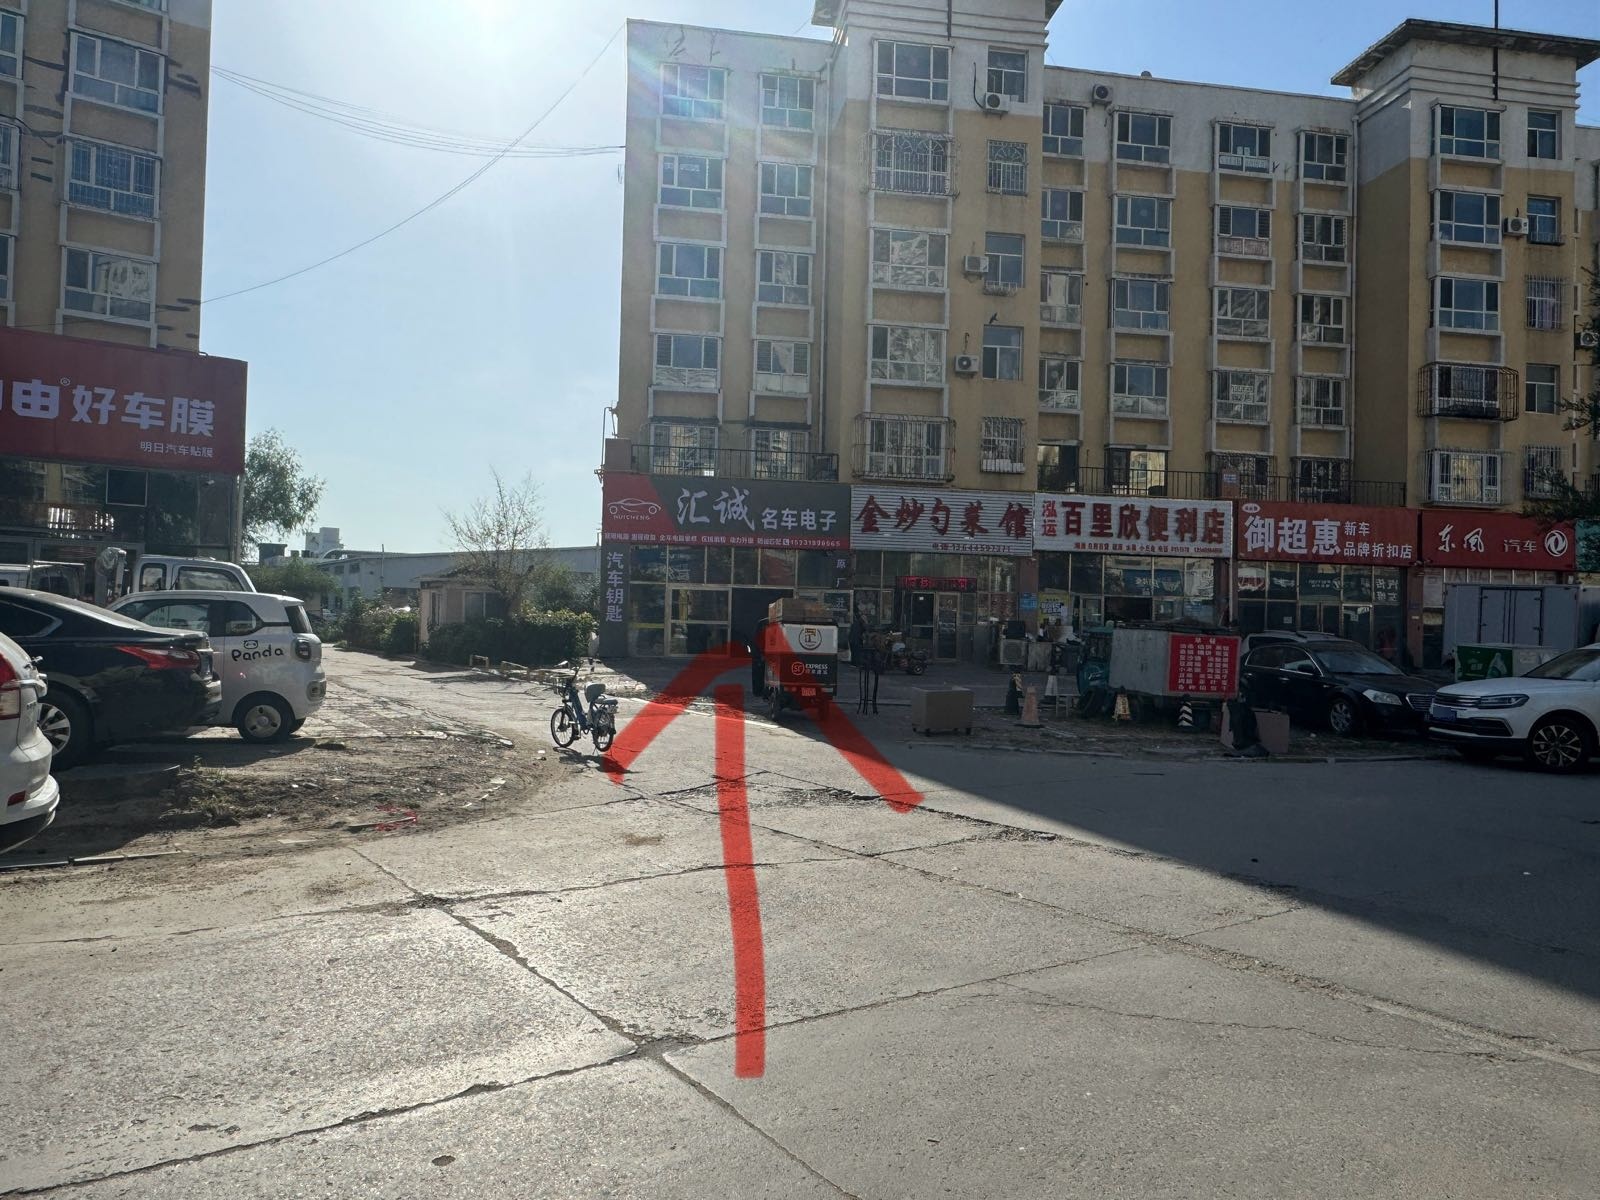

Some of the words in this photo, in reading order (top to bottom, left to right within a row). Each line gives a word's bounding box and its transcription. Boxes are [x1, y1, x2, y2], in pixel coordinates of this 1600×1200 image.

[676, 486, 755, 531] 汇诚
[761, 508, 838, 532] 名车电子
[1061, 501, 1226, 544] 百里欣便利店
[1243, 514, 1341, 557] 御超惠
[1343, 520, 1370, 536] 新车
[1343, 541, 1413, 559] 品牌折扣店
[1437, 523, 1485, 553] 东风
[1503, 538, 1537, 553] 汽车
[605, 551, 624, 623] 汽车钥匙
[231, 644, 284, 661] Panda
